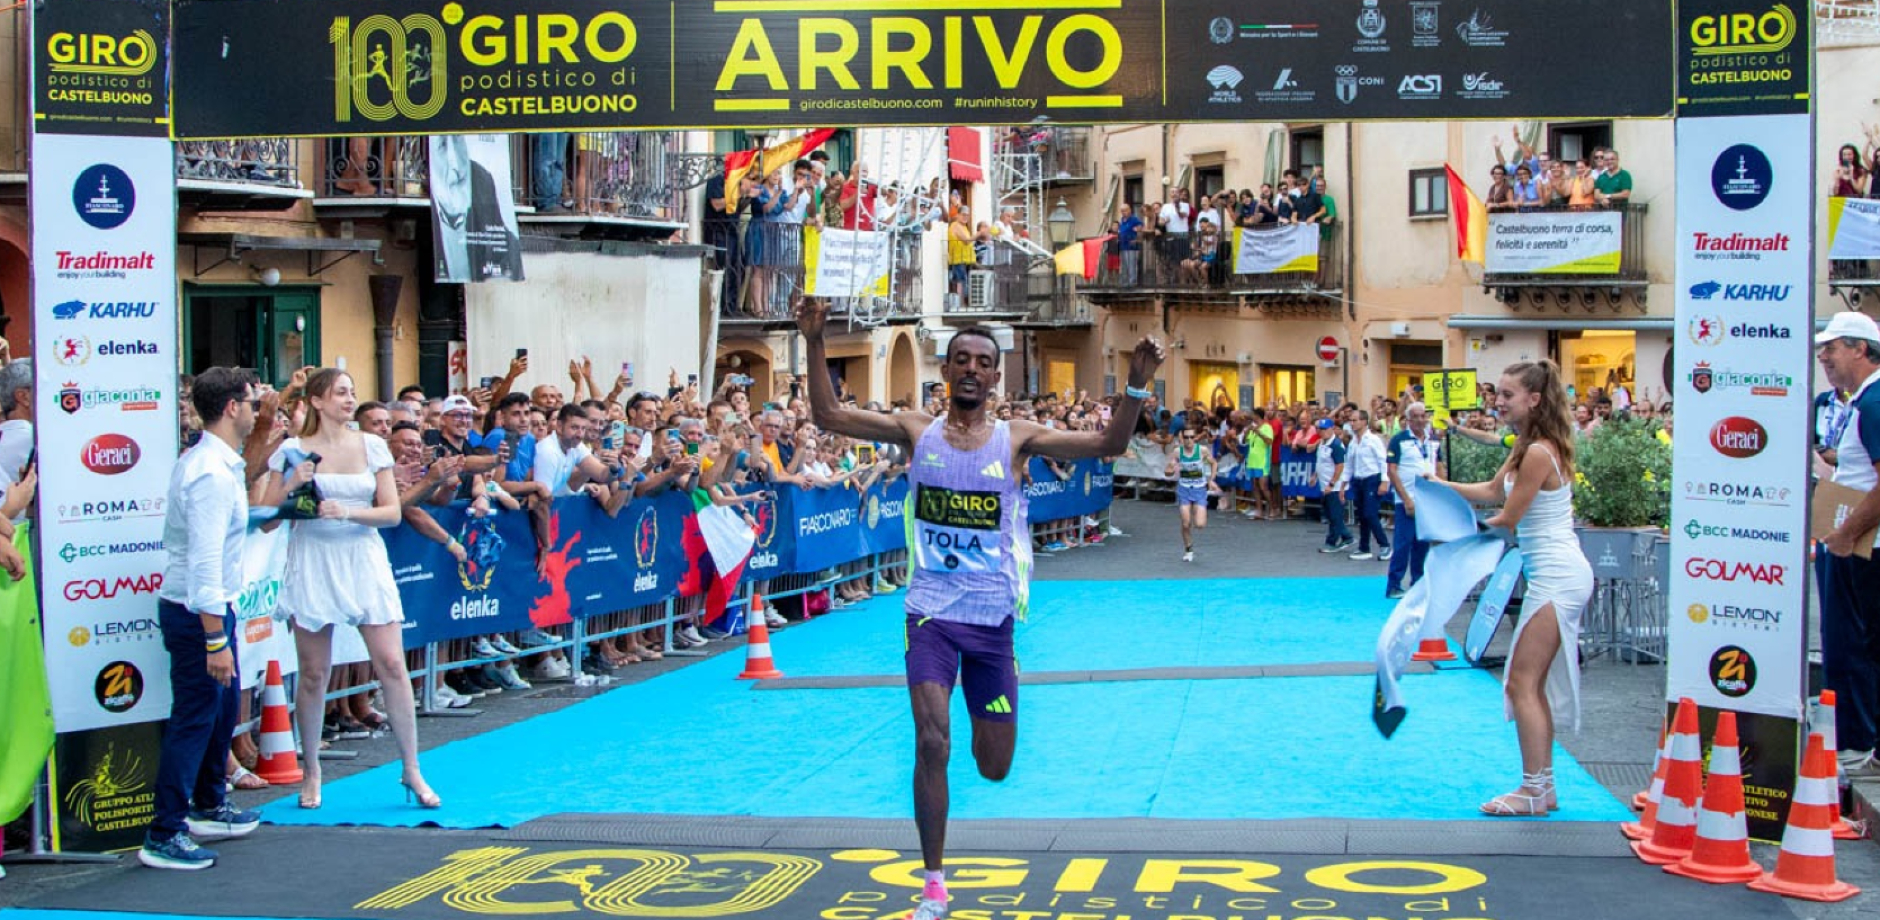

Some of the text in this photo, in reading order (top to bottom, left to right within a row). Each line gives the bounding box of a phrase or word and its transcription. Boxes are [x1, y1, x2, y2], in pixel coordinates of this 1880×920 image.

[1690, 11, 1788, 47] GIRO
[459, 11, 637, 66] GIRO
[48, 31, 149, 67] GIRO
[715, 13, 1122, 90] ARRIVO
[1690, 53, 1791, 69] podistico di
[48, 73, 152, 91] podistico di
[460, 67, 637, 93] podistico di
[1358, 77, 1385, 86] CONI
[1690, 69, 1792, 85] CASTELBUONO
[48, 90, 152, 105] CASTELBUONO
[460, 94, 637, 117] CASTELBUONO
[800, 96, 1038, 111] girodicastelbuono.com #runinhistory
[1552, 224, 1573, 234] terra
[1574, 223, 1584, 234] di
[1585, 224, 1613, 235] corsa,
[1526, 241, 1532, 250] e
[1693, 232, 1790, 251] Tradimalt
[55, 251, 155, 269] Tradimalt
[1723, 284, 1790, 301] KARHU
[89, 302, 156, 318] KARHU
[1730, 323, 1790, 338] elenka
[98, 340, 158, 355] elenka
[1432, 377, 1465, 389] GRO
[1716, 424, 1759, 450] Geraci
[88, 442, 132, 467] Geraci
[1709, 482, 1763, 499] ROMA
[83, 500, 139, 515] ROMA
[949, 494, 998, 511] GIRO
[924, 528, 983, 552] TOLA
[1703, 525, 1790, 543] BCC MADONIE
[80, 546, 106, 557] BCC
[1685, 557, 1784, 586] GOLMAR
[63, 572, 163, 601] GOLMAR
[450, 595, 500, 620] elenka
[1712, 605, 1780, 623] LEMON
[95, 619, 161, 636] LEMON
[94, 796, 132, 809] GRUPPO
[1745, 798, 1769, 808] TIVO
[1747, 810, 1779, 822] ONESE
[869, 857, 1488, 894] GIRO
[838, 891, 1488, 912] podistico di
